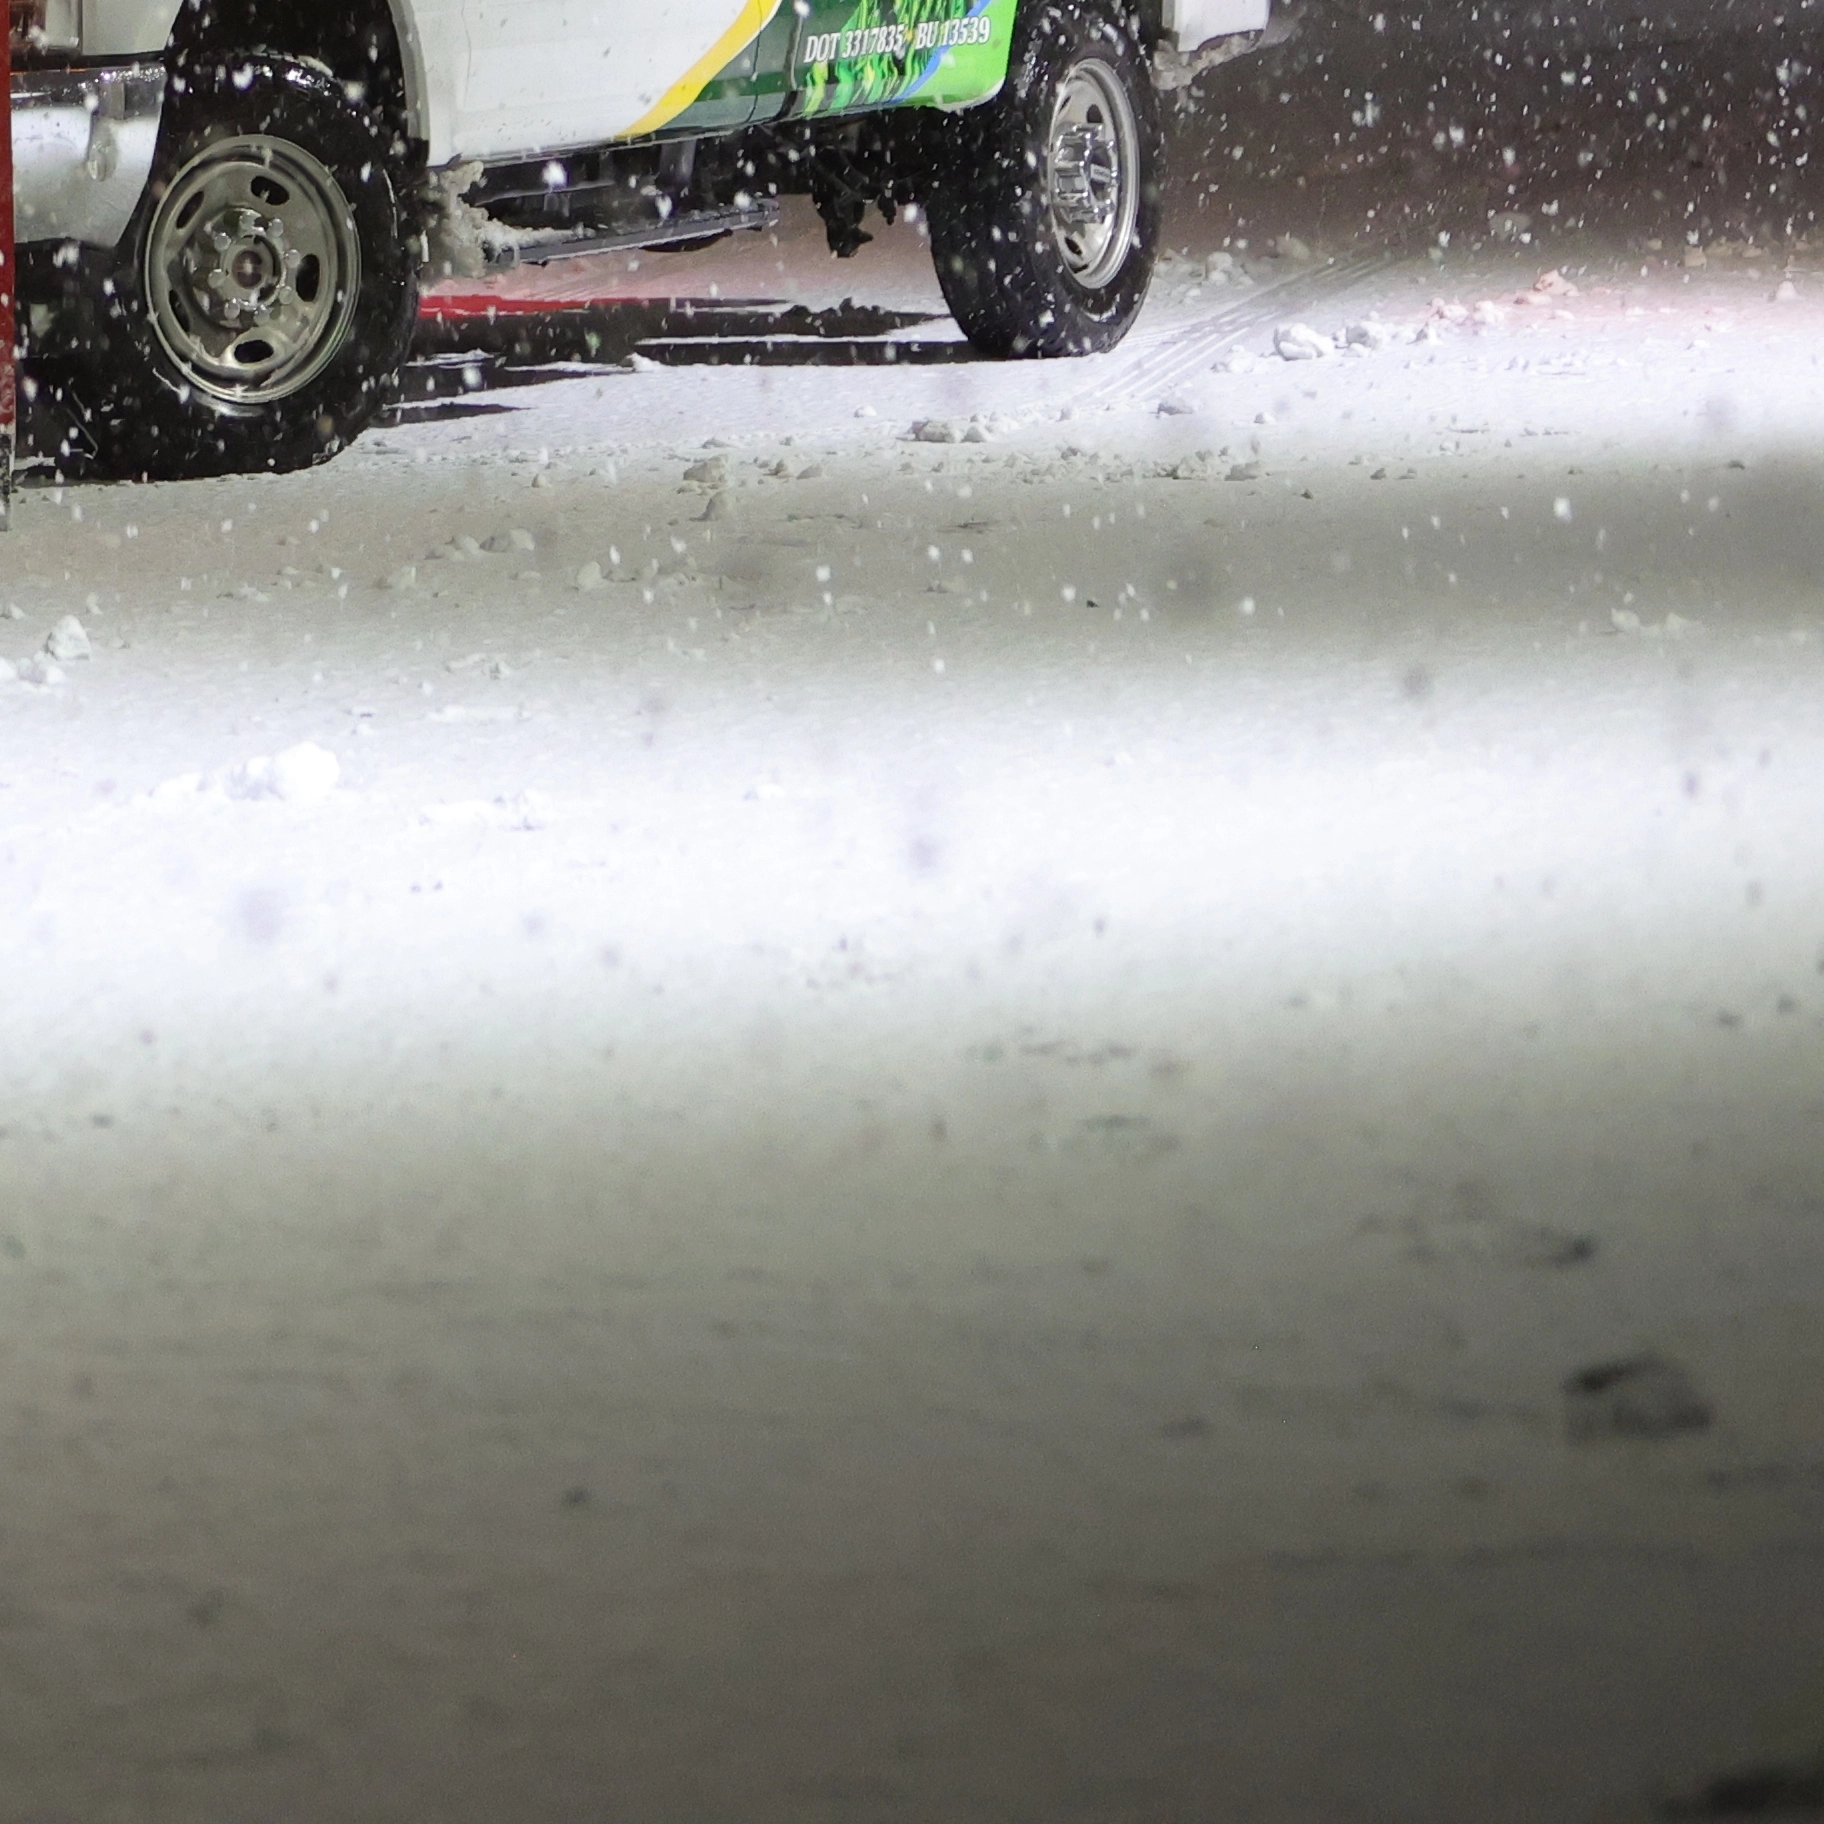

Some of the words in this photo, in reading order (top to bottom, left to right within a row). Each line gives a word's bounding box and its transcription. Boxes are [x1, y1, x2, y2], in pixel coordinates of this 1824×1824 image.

[803, 32, 841, 63] DOT
[842, 24, 904, 59] 3317835
[915, 21, 940, 50] BU
[940, 16, 992, 46] 13539
